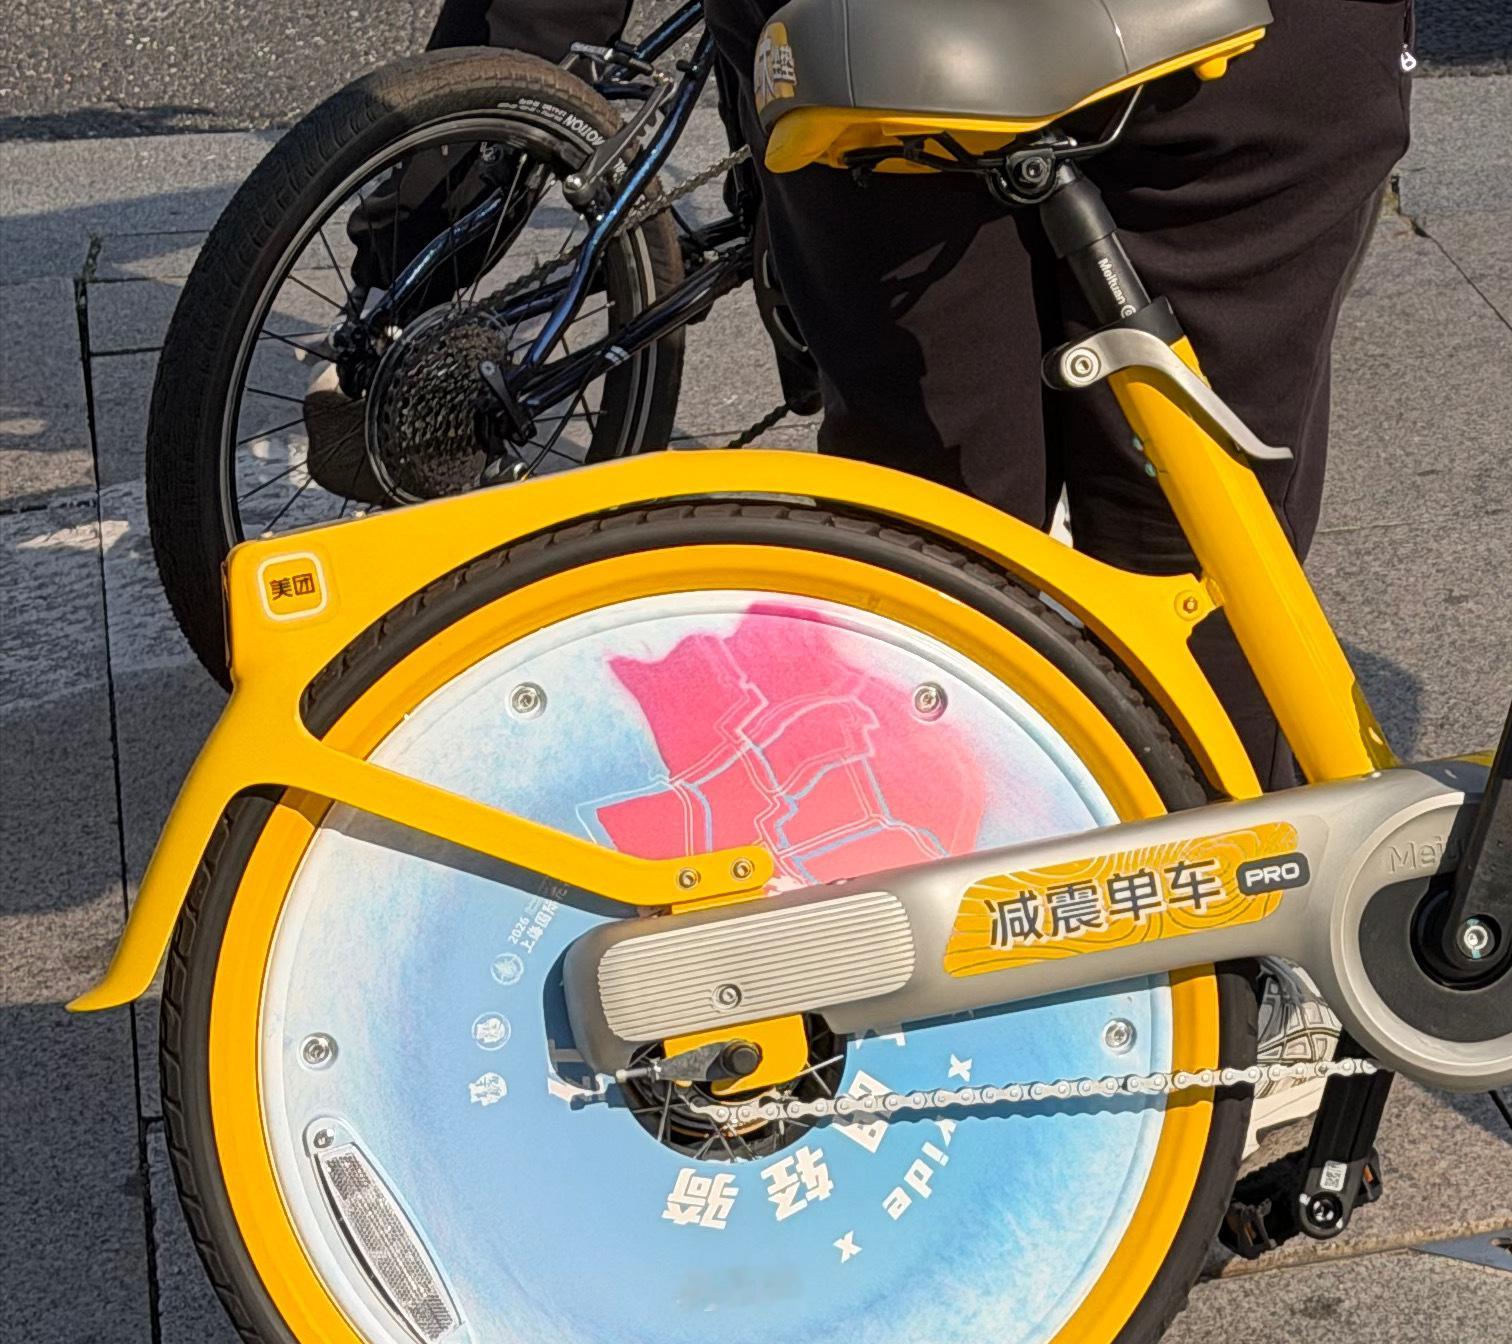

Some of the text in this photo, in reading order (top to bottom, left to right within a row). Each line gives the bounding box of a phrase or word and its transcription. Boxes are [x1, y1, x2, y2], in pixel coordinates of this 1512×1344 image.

[1097, 257, 1126, 305] Meituan
[269, 573, 316, 601] 美团
[987, 859, 1301, 951] 减震单车 PRO
[508, 917, 529, 945] 2026
